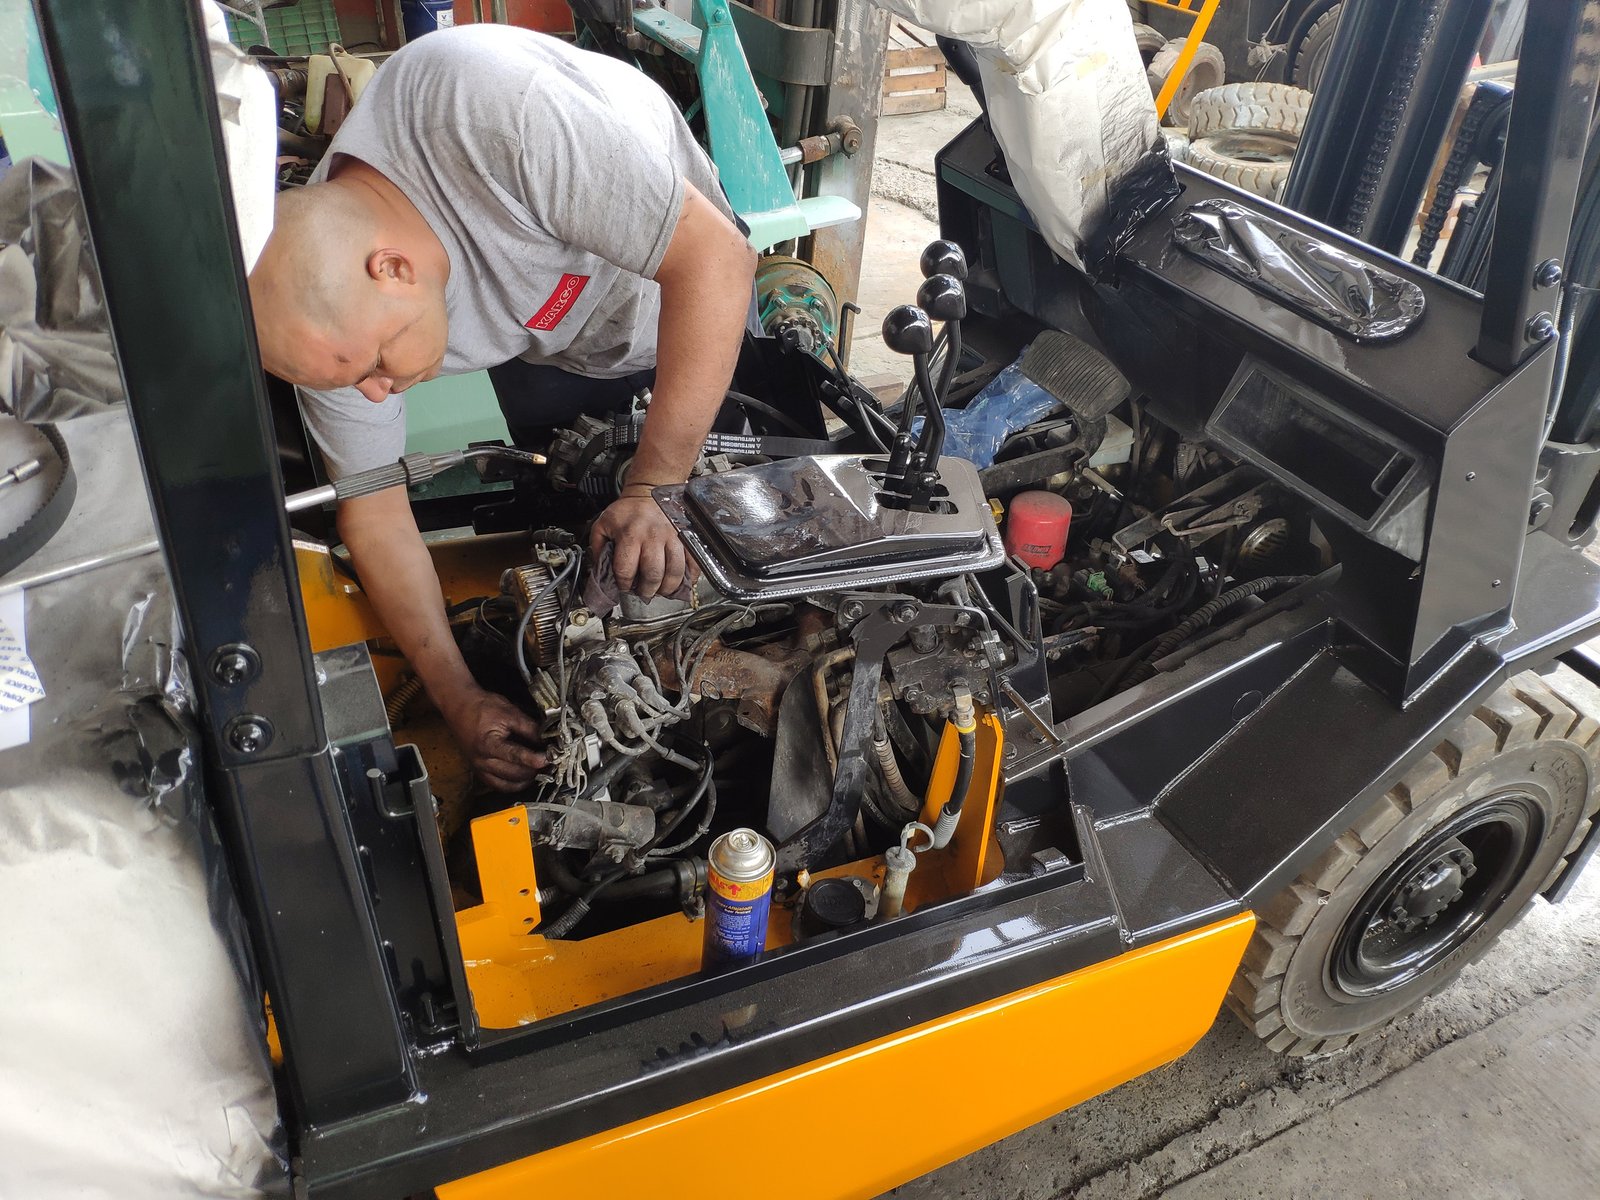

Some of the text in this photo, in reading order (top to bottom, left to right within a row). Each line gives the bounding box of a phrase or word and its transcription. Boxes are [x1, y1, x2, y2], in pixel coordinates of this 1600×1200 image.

[535, 276, 580, 329] KARGO
[720, 441, 755, 449] MITSUBOSHI
[5, 679, 35, 693] SOURCE
